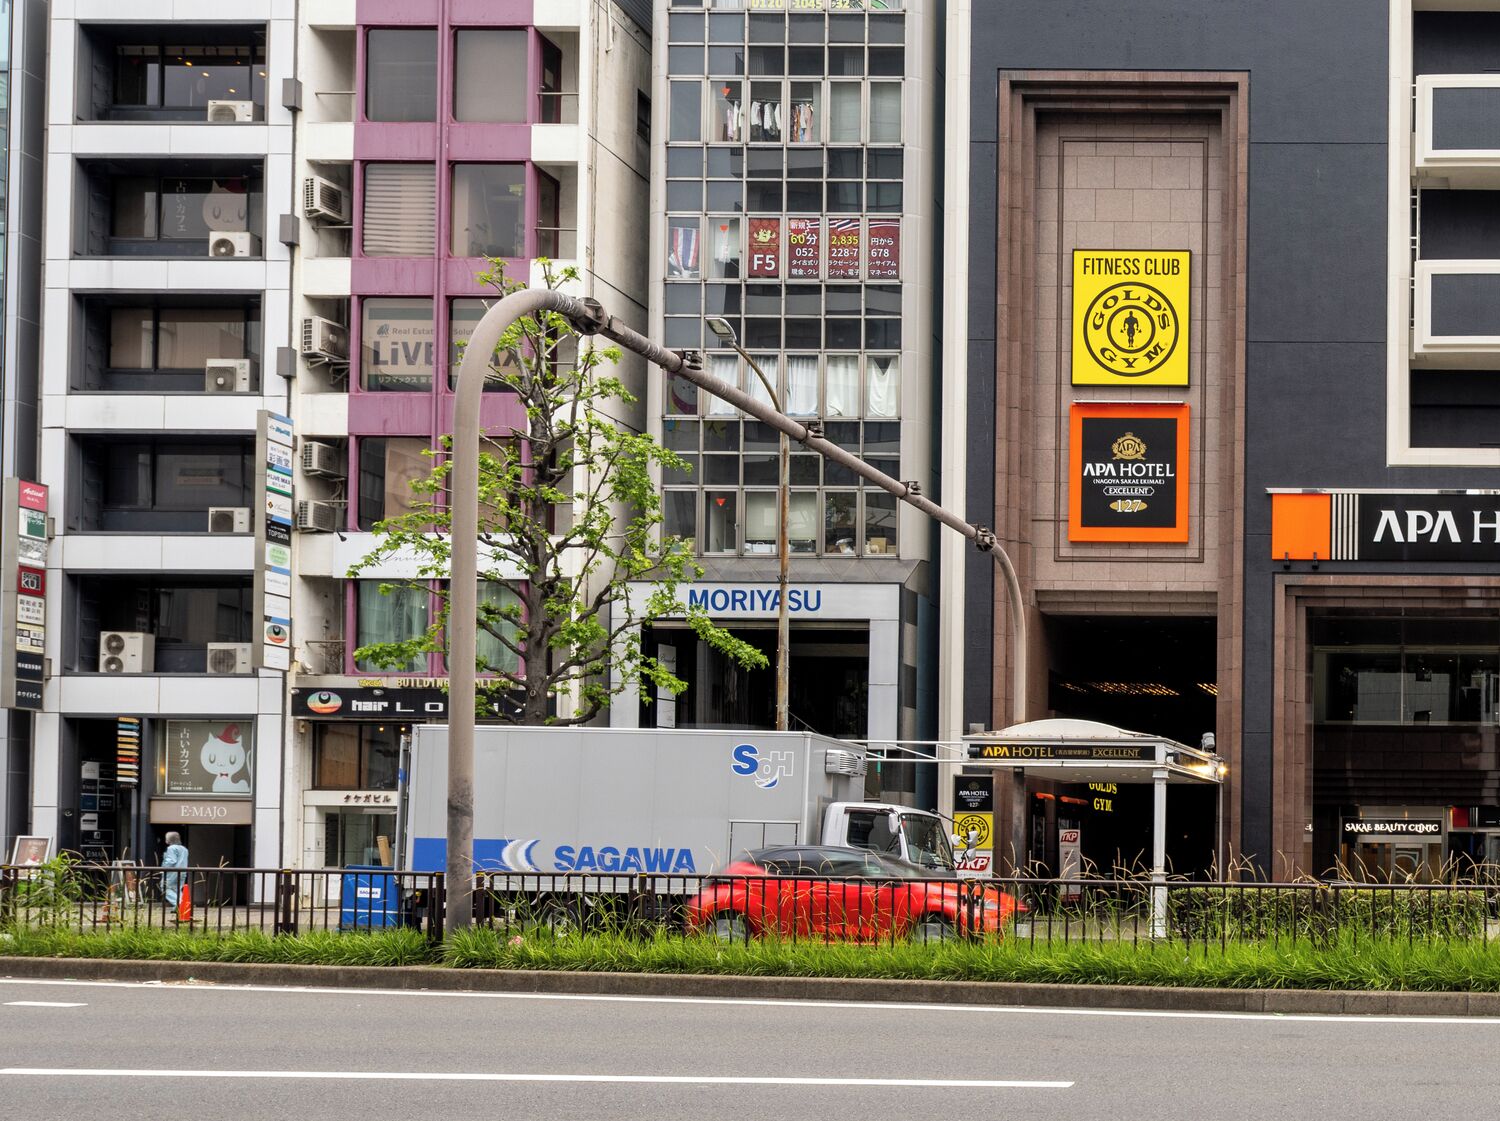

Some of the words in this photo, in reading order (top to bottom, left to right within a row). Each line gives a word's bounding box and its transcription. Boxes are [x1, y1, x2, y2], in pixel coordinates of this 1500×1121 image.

[753, 254, 776, 270] F5
[1083, 258, 1140, 275] FITNESS
[1144, 258, 1180, 275] CLUB
[1093, 290, 1170, 330] GOLD'S
[1100, 342, 1165, 368] GYM
[1083, 463, 1116, 476] APA
[1120, 463, 1175, 477] HOTEL
[1117, 500, 1141, 512] 127
[1373, 511, 1461, 543] APA
[352, 700, 388, 711] hair
[179, 728, 190, 775] 占いカフェ
[983, 747, 1008, 757] APA
[1012, 747, 1054, 757] HOTEL
[1092, 749, 1141, 758] EXCELLENT
[1094, 798, 1112, 812] GYM
[1345, 823, 1372, 832] SAKAE
[1374, 823, 1407, 832] BEAUTY
[1408, 823, 1439, 832] CLINIC
[554, 845, 695, 873] SAGAWA
